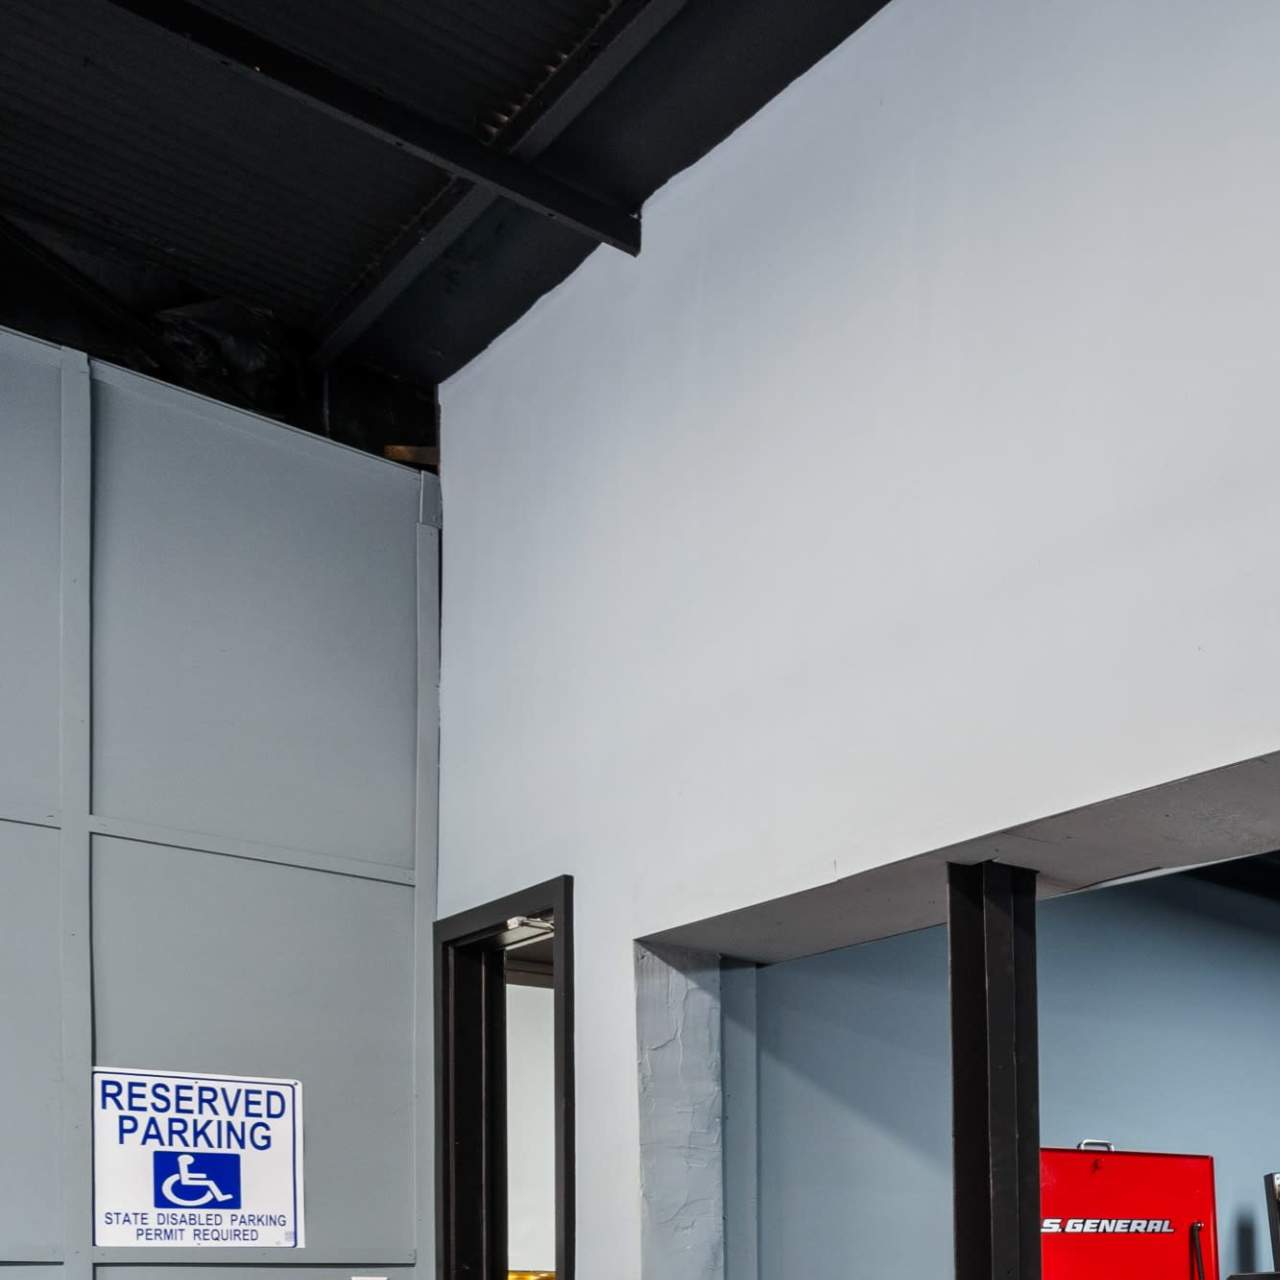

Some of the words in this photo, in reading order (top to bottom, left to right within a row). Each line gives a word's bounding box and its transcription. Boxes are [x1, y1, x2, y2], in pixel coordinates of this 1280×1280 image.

[101, 1080, 286, 1119] RESERVED
[118, 1115, 272, 1151] PARKING
[104, 1212, 149, 1226] STATE
[157, 1212, 223, 1226] DISABLED
[230, 1213, 287, 1227] PARKING
[1064, 1218, 1175, 1234] GENERAL
[136, 1228, 185, 1241] PERMIT
[193, 1229, 259, 1242] REQUIRED
